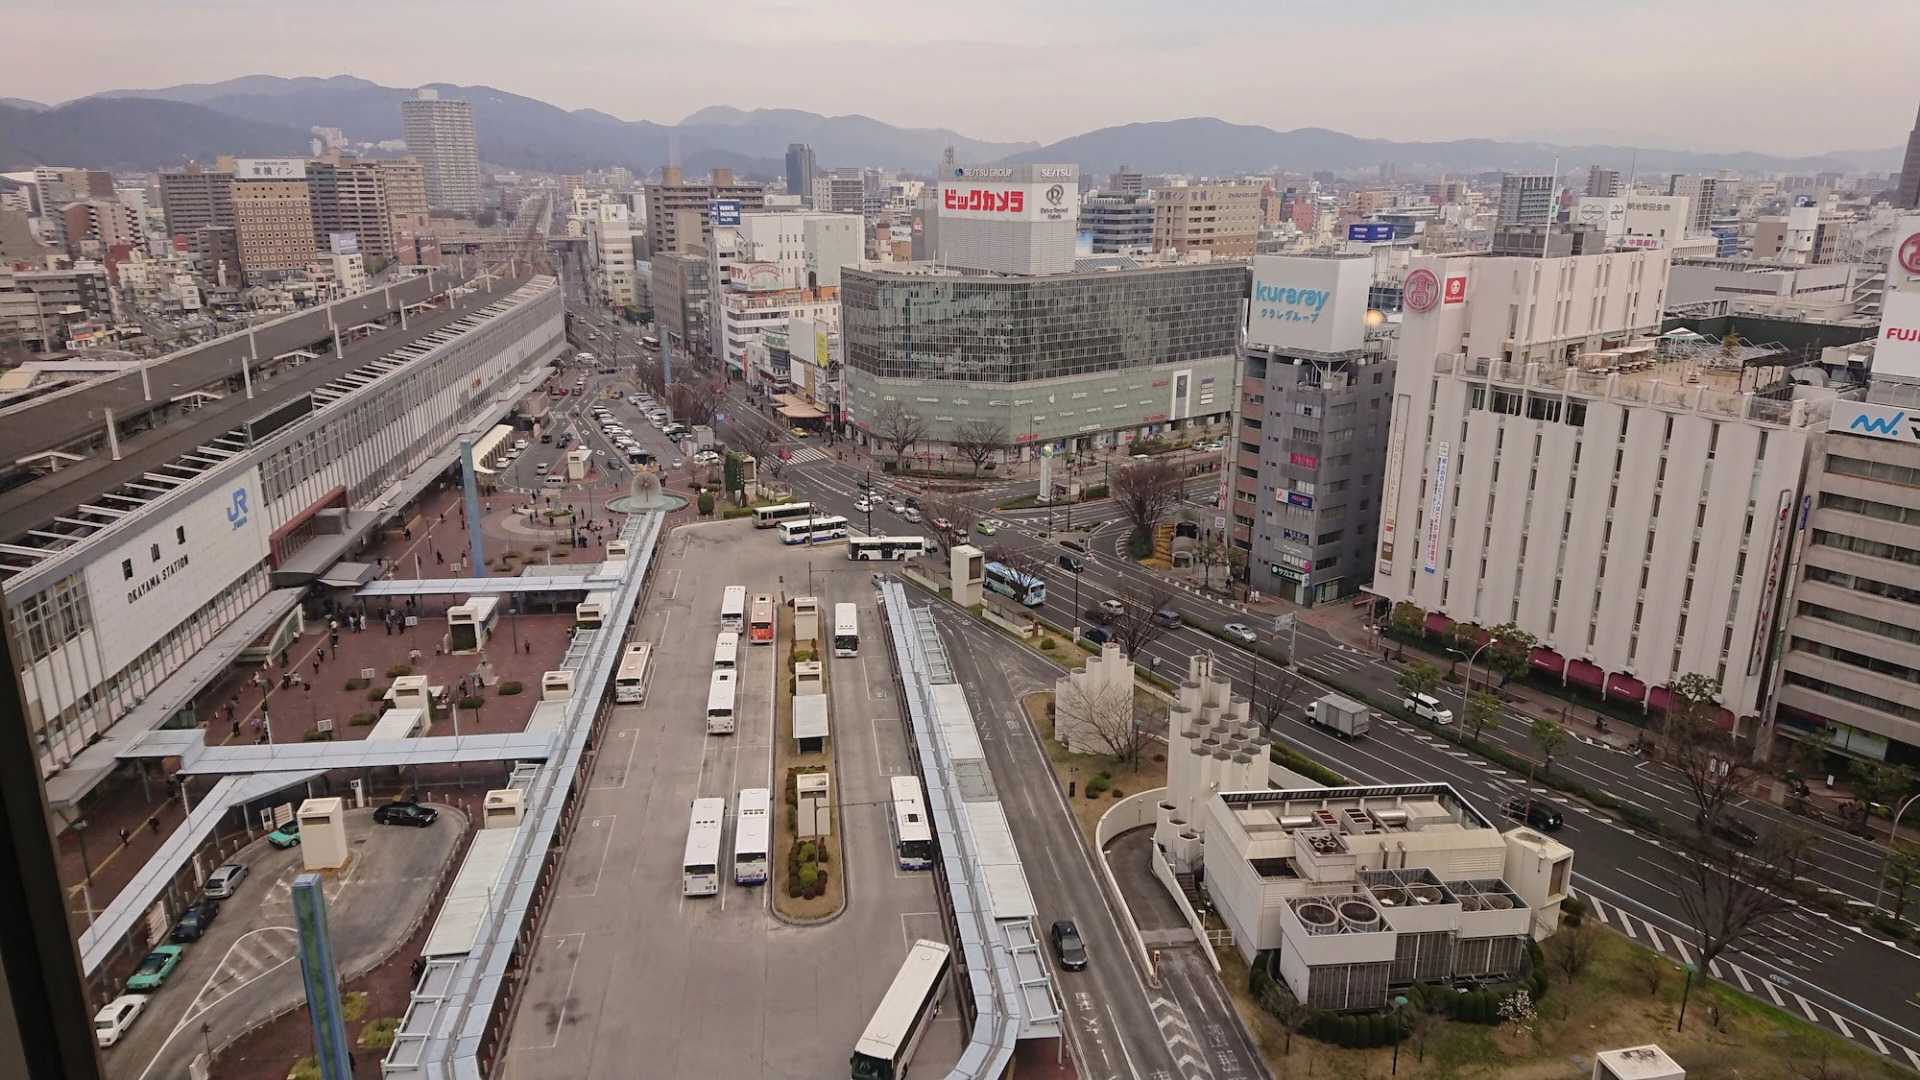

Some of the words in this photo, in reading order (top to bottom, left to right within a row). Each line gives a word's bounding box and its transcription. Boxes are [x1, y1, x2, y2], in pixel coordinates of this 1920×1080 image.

[990, 169, 1013, 177] GROUP
[944, 189, 1024, 213] ビックカメラ
[1626, 202, 1671, 211] 明治安田生命
[1255, 280, 1329, 311] kuraray
[1260, 308, 1319, 323] クラレグループ
[1886, 327, 1920, 342] FUJ
[227, 488, 248, 522] JR
[127, 574, 160, 604] OKAYAMA
[162, 554, 189, 580] STATION
